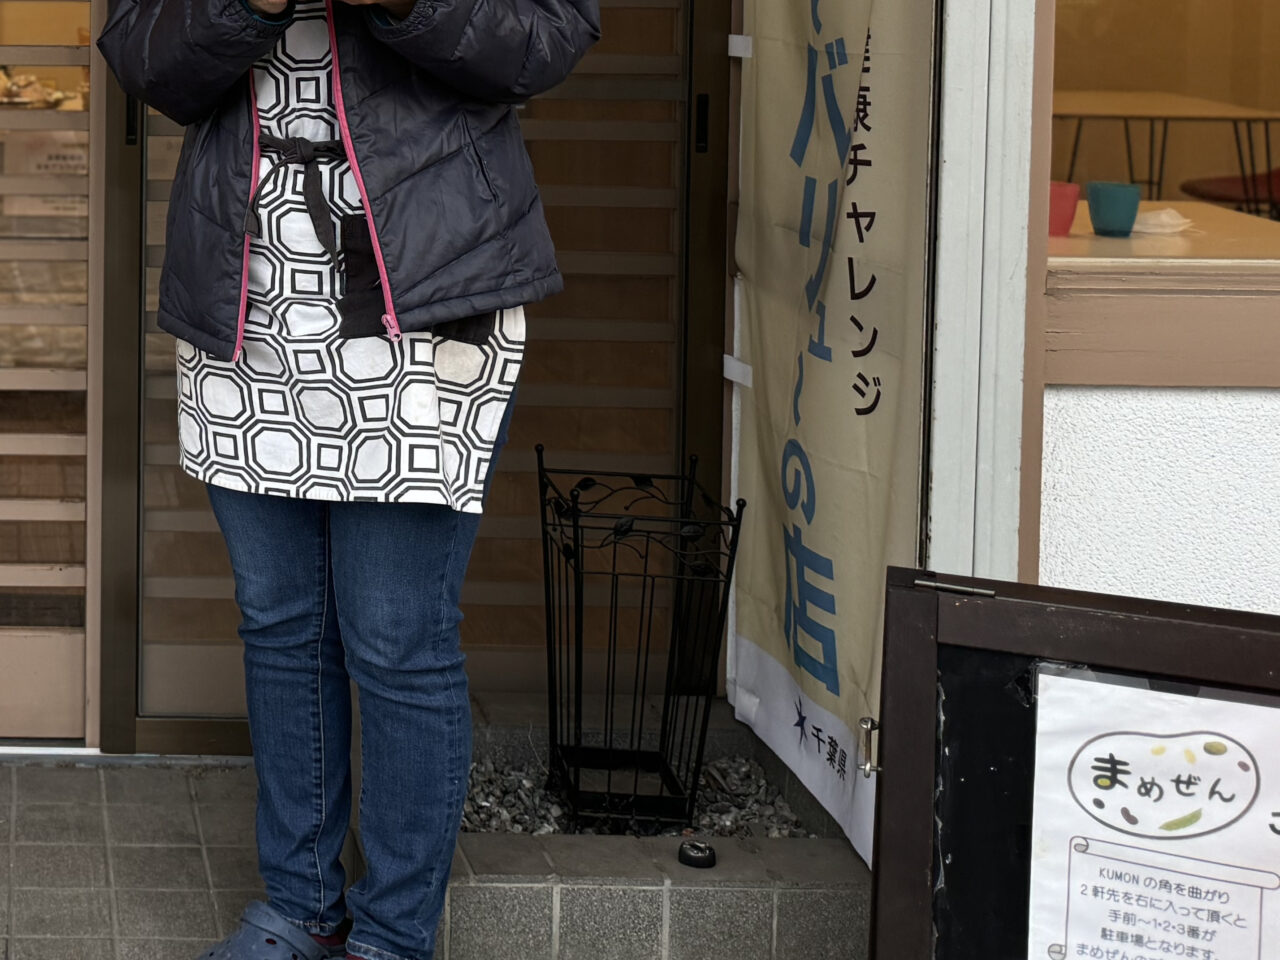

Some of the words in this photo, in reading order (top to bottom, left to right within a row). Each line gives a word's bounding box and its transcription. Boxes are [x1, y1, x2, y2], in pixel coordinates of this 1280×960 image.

[1091, 753, 1236, 803] まめぜん
[1099, 867, 1140, 885] KUMON
